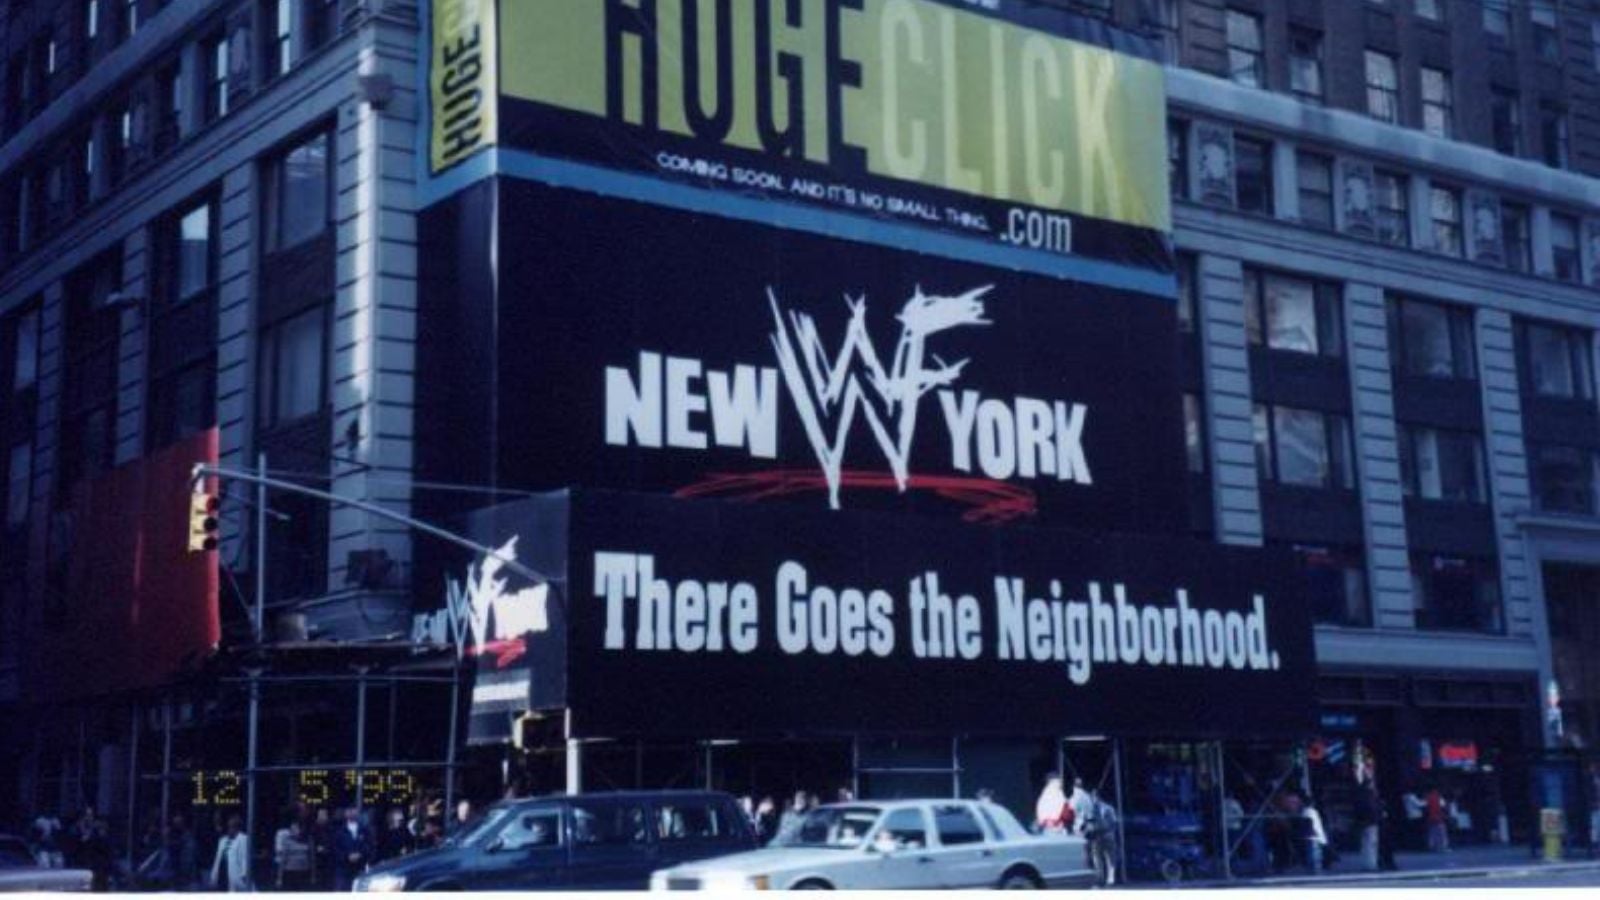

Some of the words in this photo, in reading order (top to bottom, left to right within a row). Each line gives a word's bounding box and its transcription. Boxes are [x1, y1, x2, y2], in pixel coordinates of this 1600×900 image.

[657, 152, 727, 179] COMING
[790, 178, 825, 199] AND
[860, 193, 883, 210] NO
[886, 197, 940, 221] SMALL
[1000, 208, 1072, 253] .com
[605, 350, 778, 459] NEW
[938, 390, 1093, 485] YORK
[594, 551, 759, 652] There
[775, 560, 895, 657] Goes
[909, 571, 982, 660] the
[994, 575, 1281, 686] Neighborhood.
